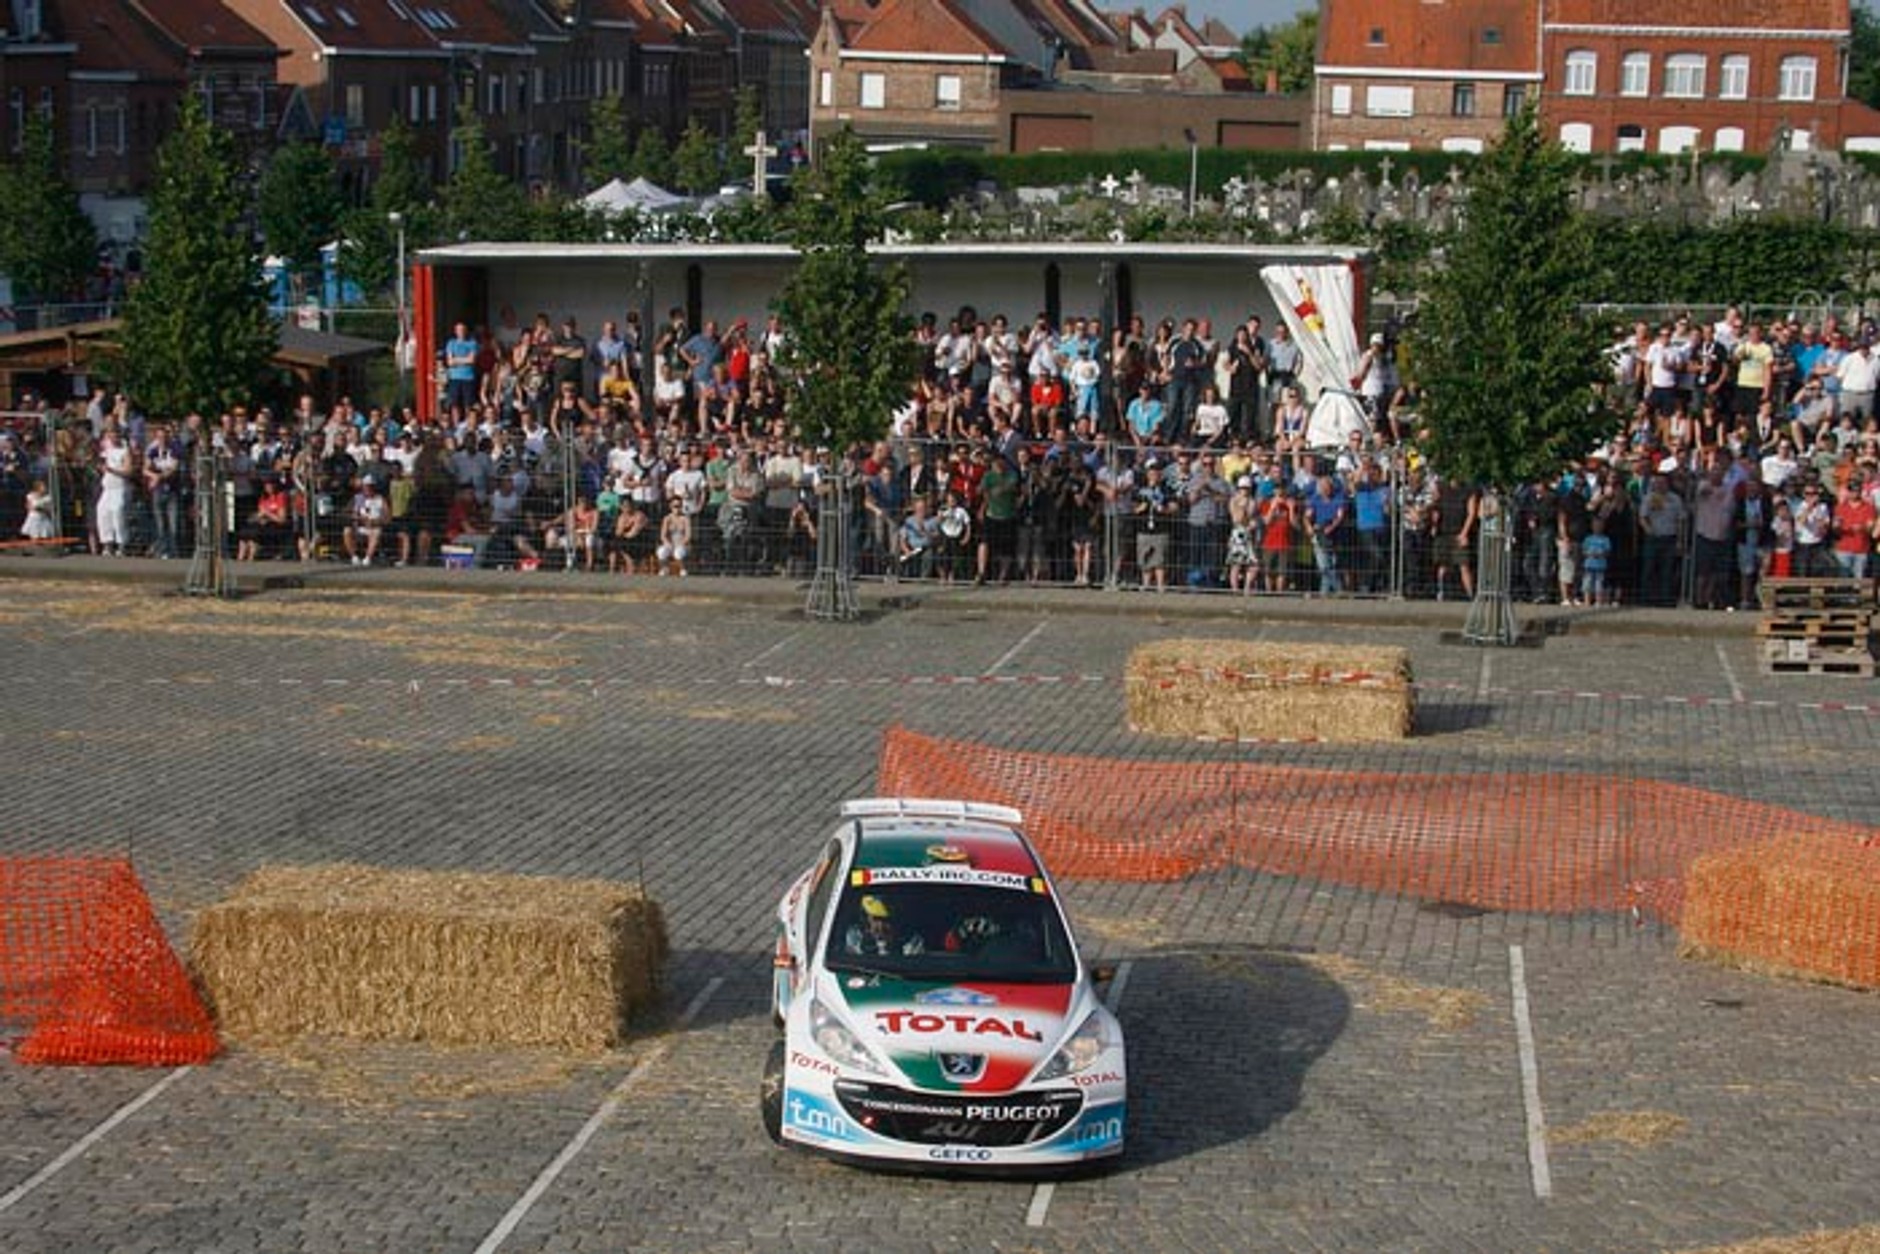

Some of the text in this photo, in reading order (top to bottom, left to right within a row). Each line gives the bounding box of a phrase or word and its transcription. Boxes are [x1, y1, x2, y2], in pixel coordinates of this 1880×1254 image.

[875, 1009, 1043, 1042] TOTAL
[791, 1051, 839, 1075] TOTAL
[1071, 1072, 1123, 1086] TOTAL
[790, 1098, 846, 1135] tmn
[966, 1105, 1062, 1121] PEUGEOT
[929, 1148, 993, 1161] GEFCO
